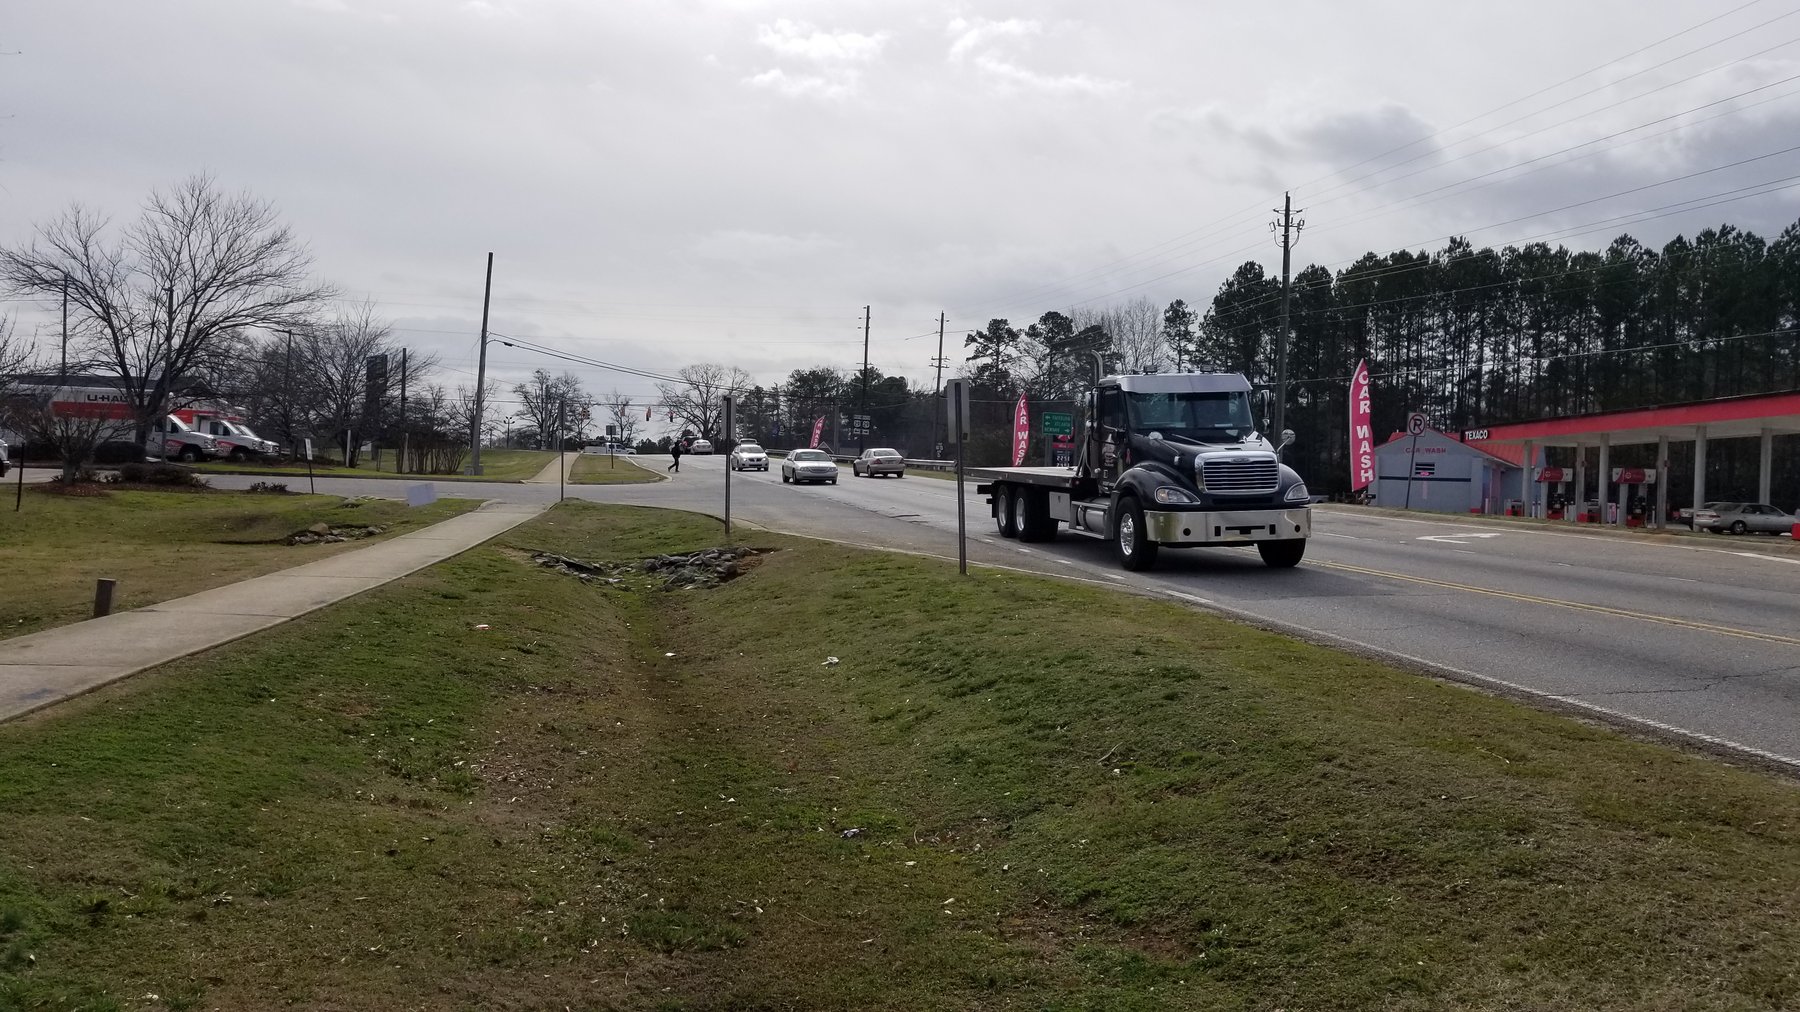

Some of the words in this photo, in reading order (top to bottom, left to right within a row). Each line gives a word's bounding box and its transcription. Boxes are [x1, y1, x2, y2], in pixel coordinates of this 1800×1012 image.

[87, 394, 129, 402] U-HAU
[1358, 370, 1371, 414] CAR
[1020, 399, 1028, 425] CAR
[1015, 430, 1029, 466] WASH
[1465, 429, 1489, 441] TEXACO
[1356, 425, 1374, 482] WASH
